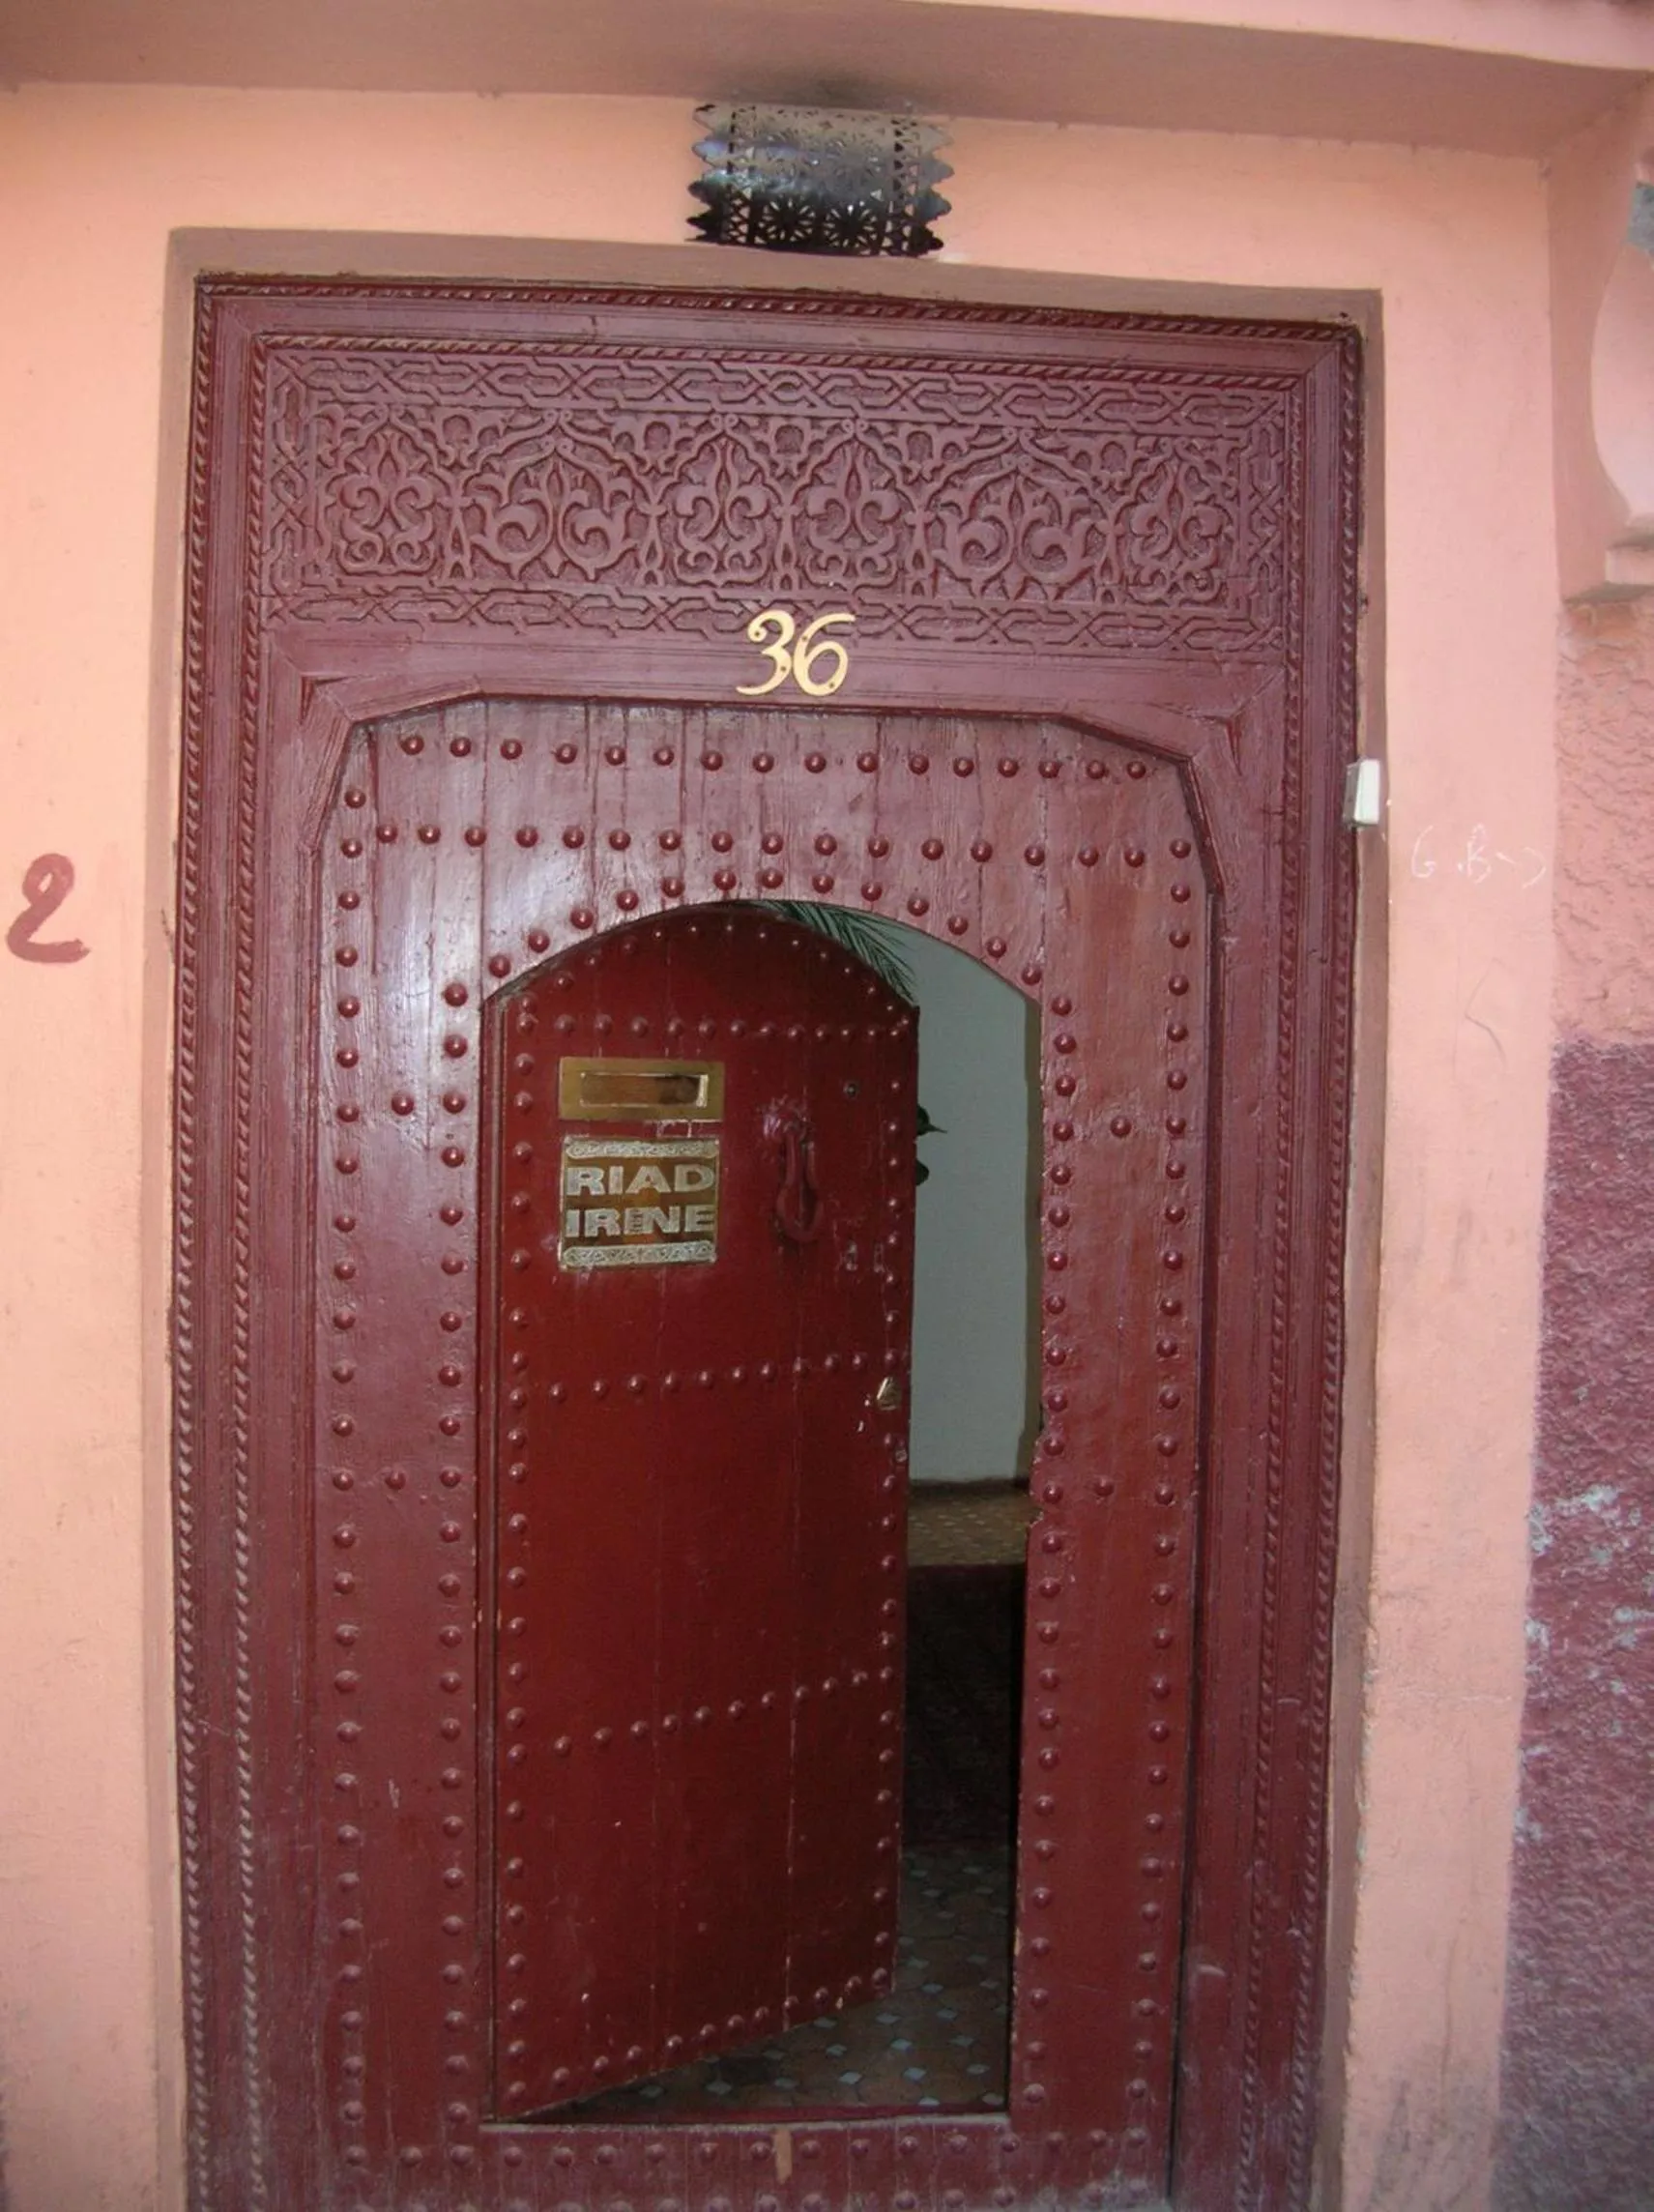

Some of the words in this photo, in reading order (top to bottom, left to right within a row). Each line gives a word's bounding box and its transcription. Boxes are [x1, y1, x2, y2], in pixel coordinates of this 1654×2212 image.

[736, 609, 856, 696] 36
[6, 853, 91, 964] 2
[565, 1164, 715, 1196] RIAD
[565, 1205, 715, 1237] IRENE
